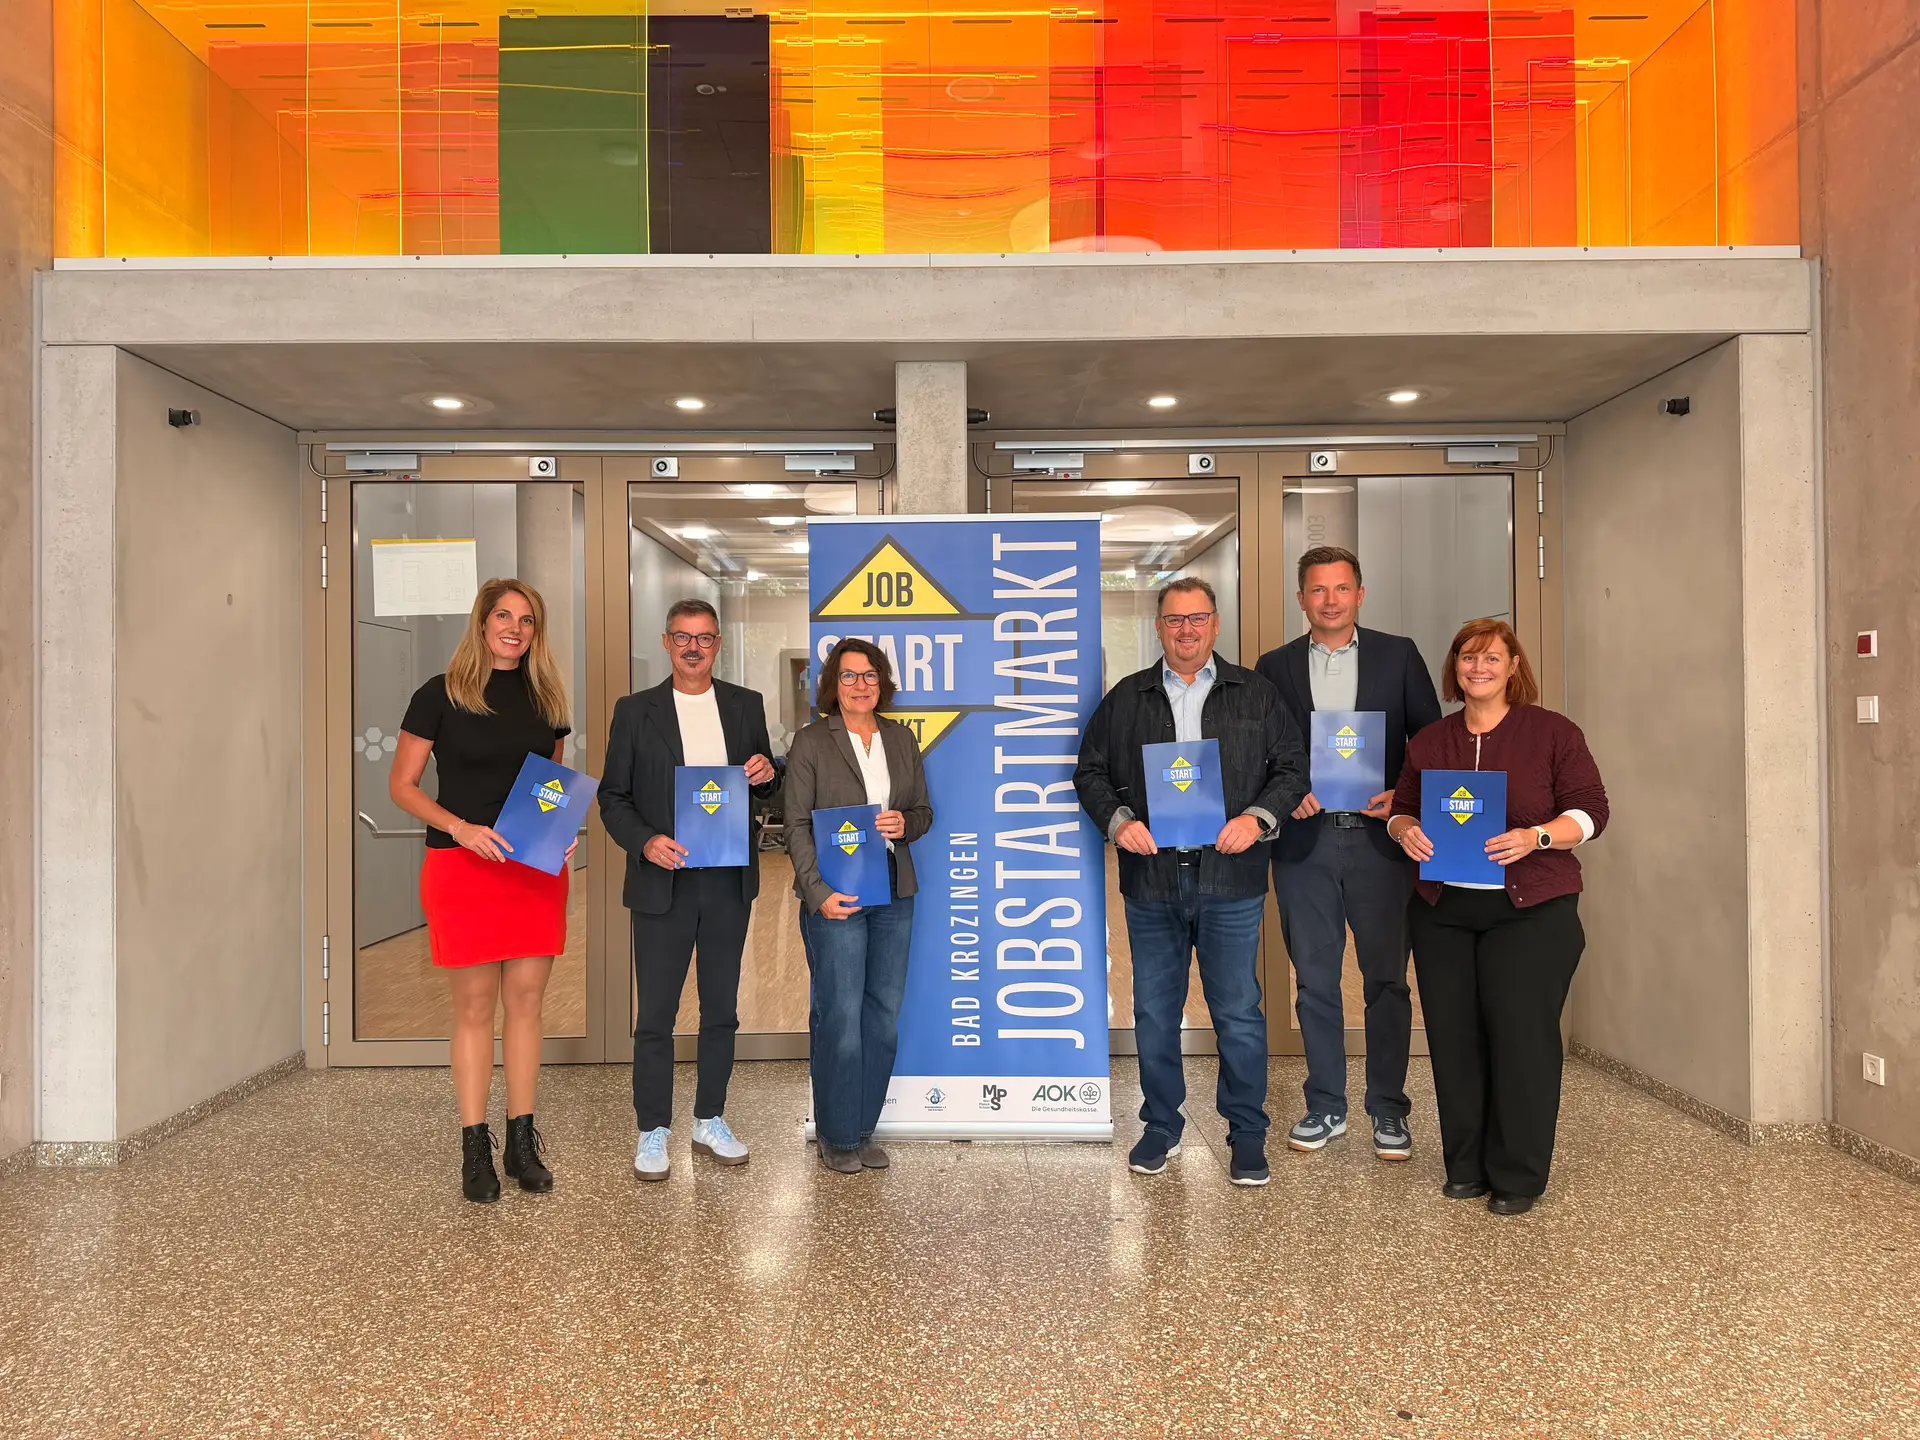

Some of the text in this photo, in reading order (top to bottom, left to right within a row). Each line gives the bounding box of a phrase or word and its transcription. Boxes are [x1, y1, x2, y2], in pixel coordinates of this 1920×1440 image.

[862, 572, 914, 608] JOB
[1335, 737, 1358, 747] START
[1170, 769, 1193, 780] START
[538, 787, 563, 804] START
[700, 792, 722, 802] START
[993, 533, 1085, 1049] JOBSTARTMARKT
[1449, 799, 1475, 811] START
[838, 832, 859, 843] START
[949, 832, 981, 1046] BAD KROZINGEN
[1032, 1084, 1077, 1102] AOK
